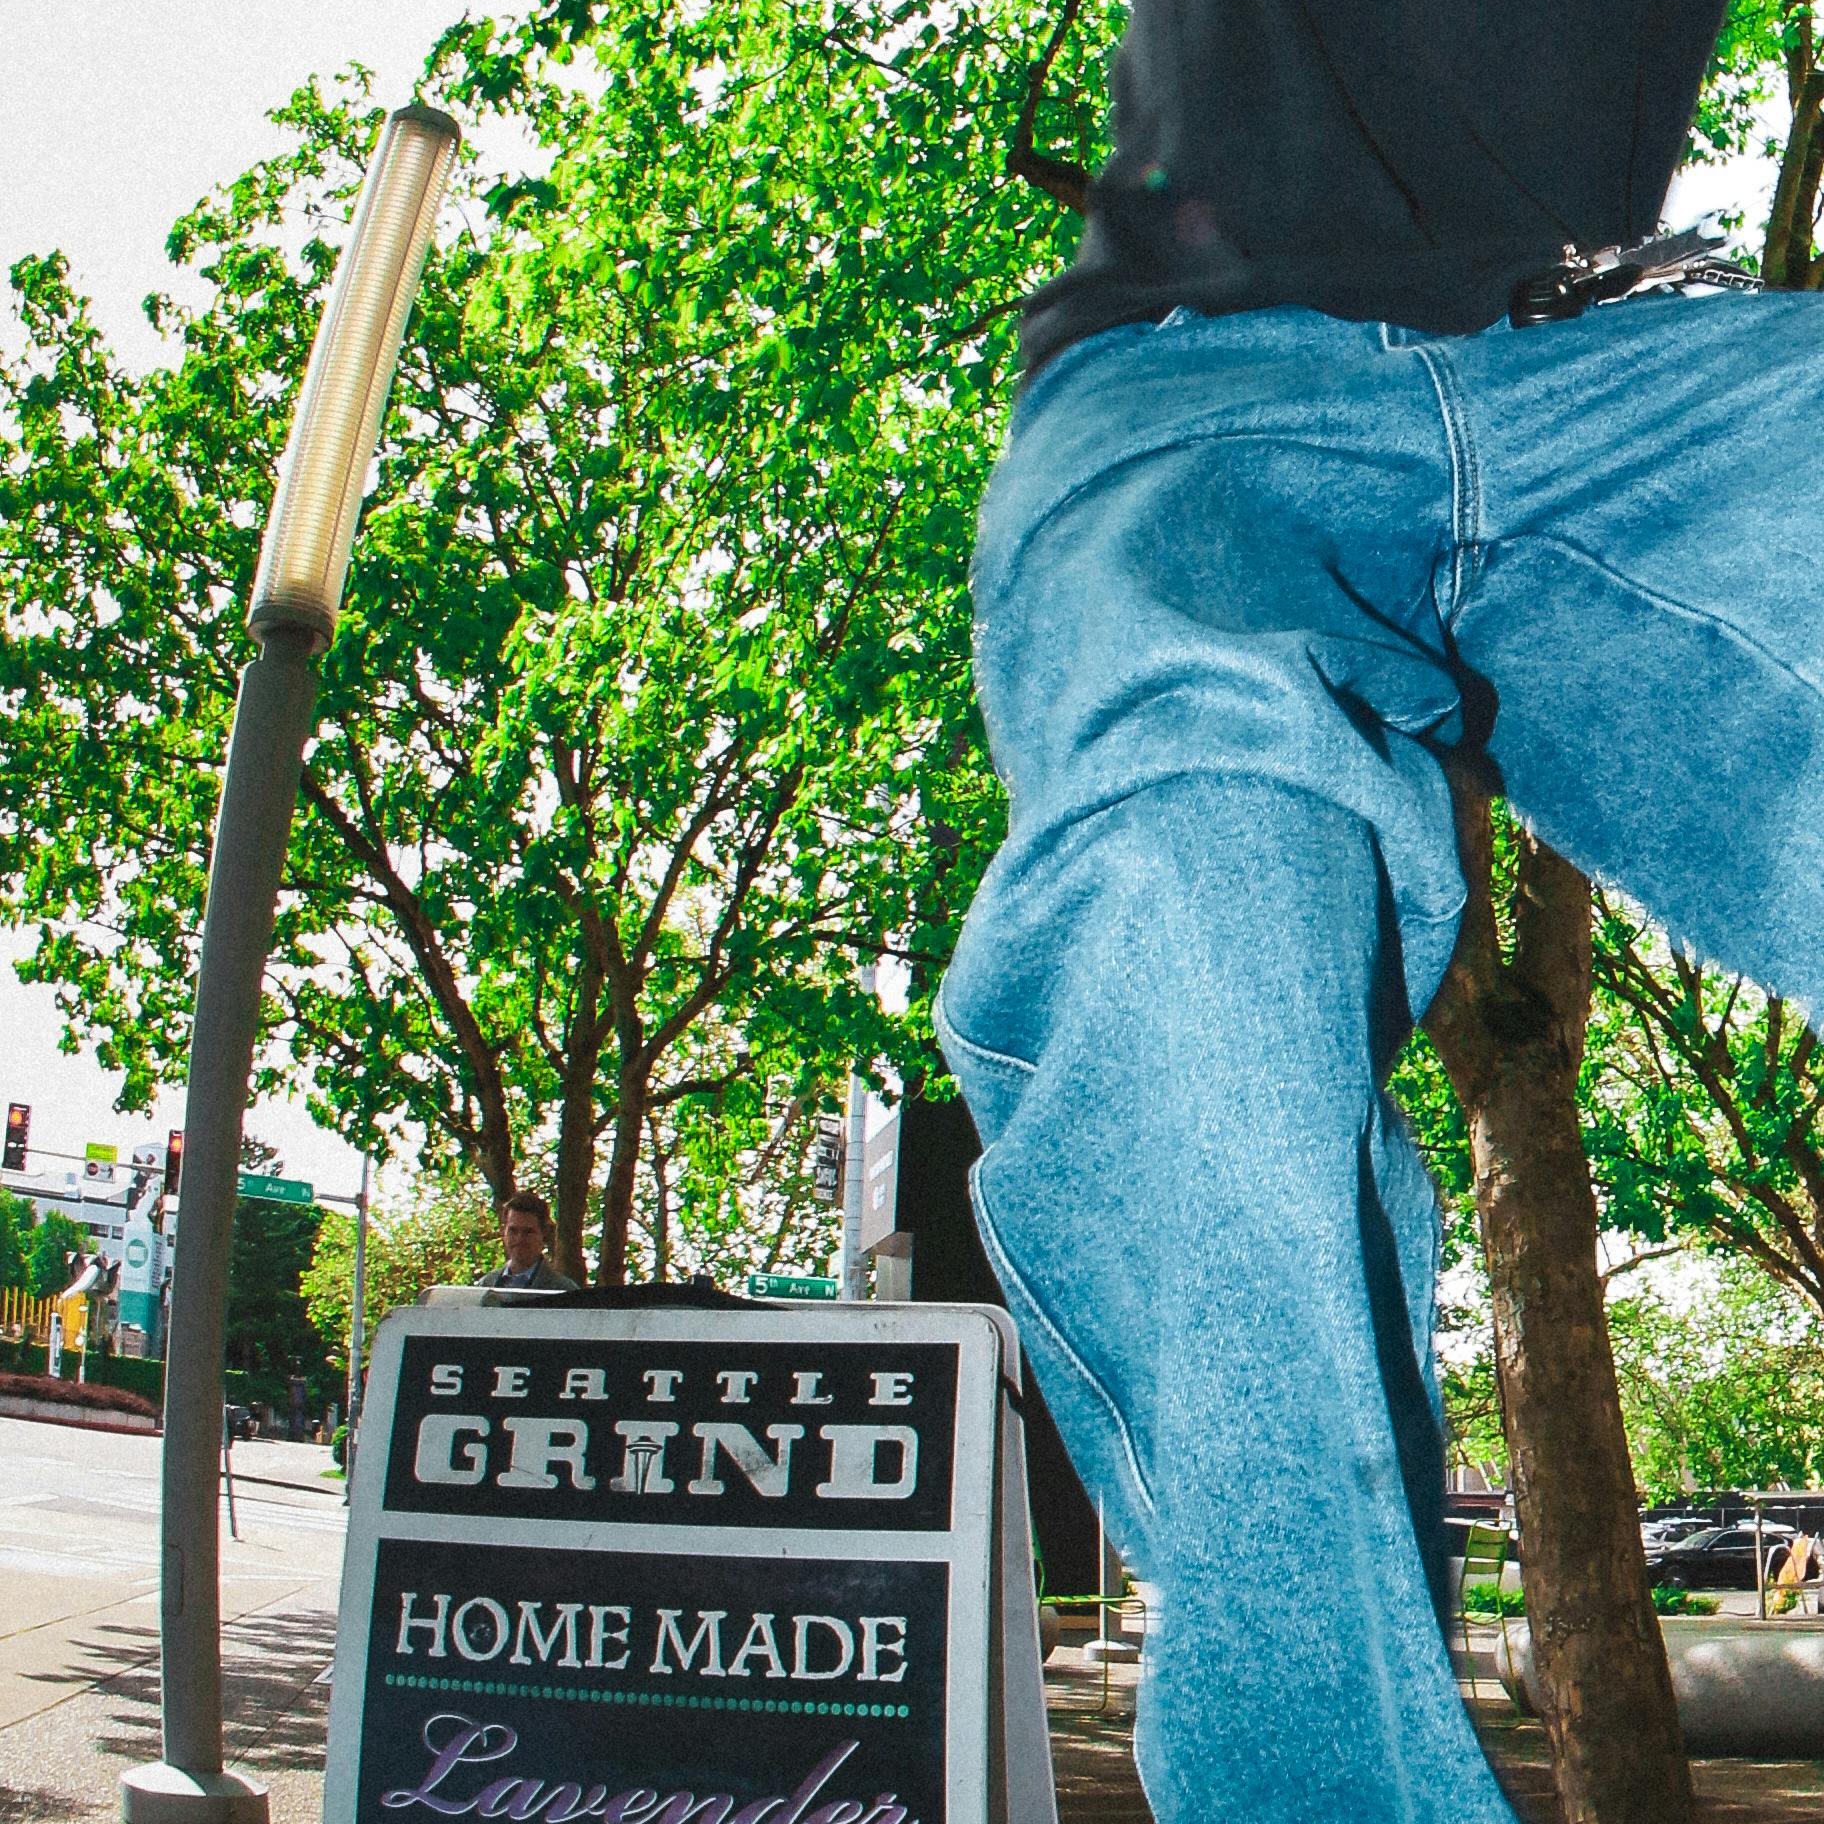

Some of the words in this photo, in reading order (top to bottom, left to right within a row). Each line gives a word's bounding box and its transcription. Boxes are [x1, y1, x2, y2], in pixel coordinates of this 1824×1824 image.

[754, 1276, 779, 1295] 5th
[788, 1282, 811, 1296] Ave
[824, 1284, 835, 1297] N
[430, 1364, 915, 1406] SEATTLE
[414, 1413, 920, 1500] GRIND
[395, 1591, 631, 1669] HOME
[648, 1607, 909, 1682] MADE
